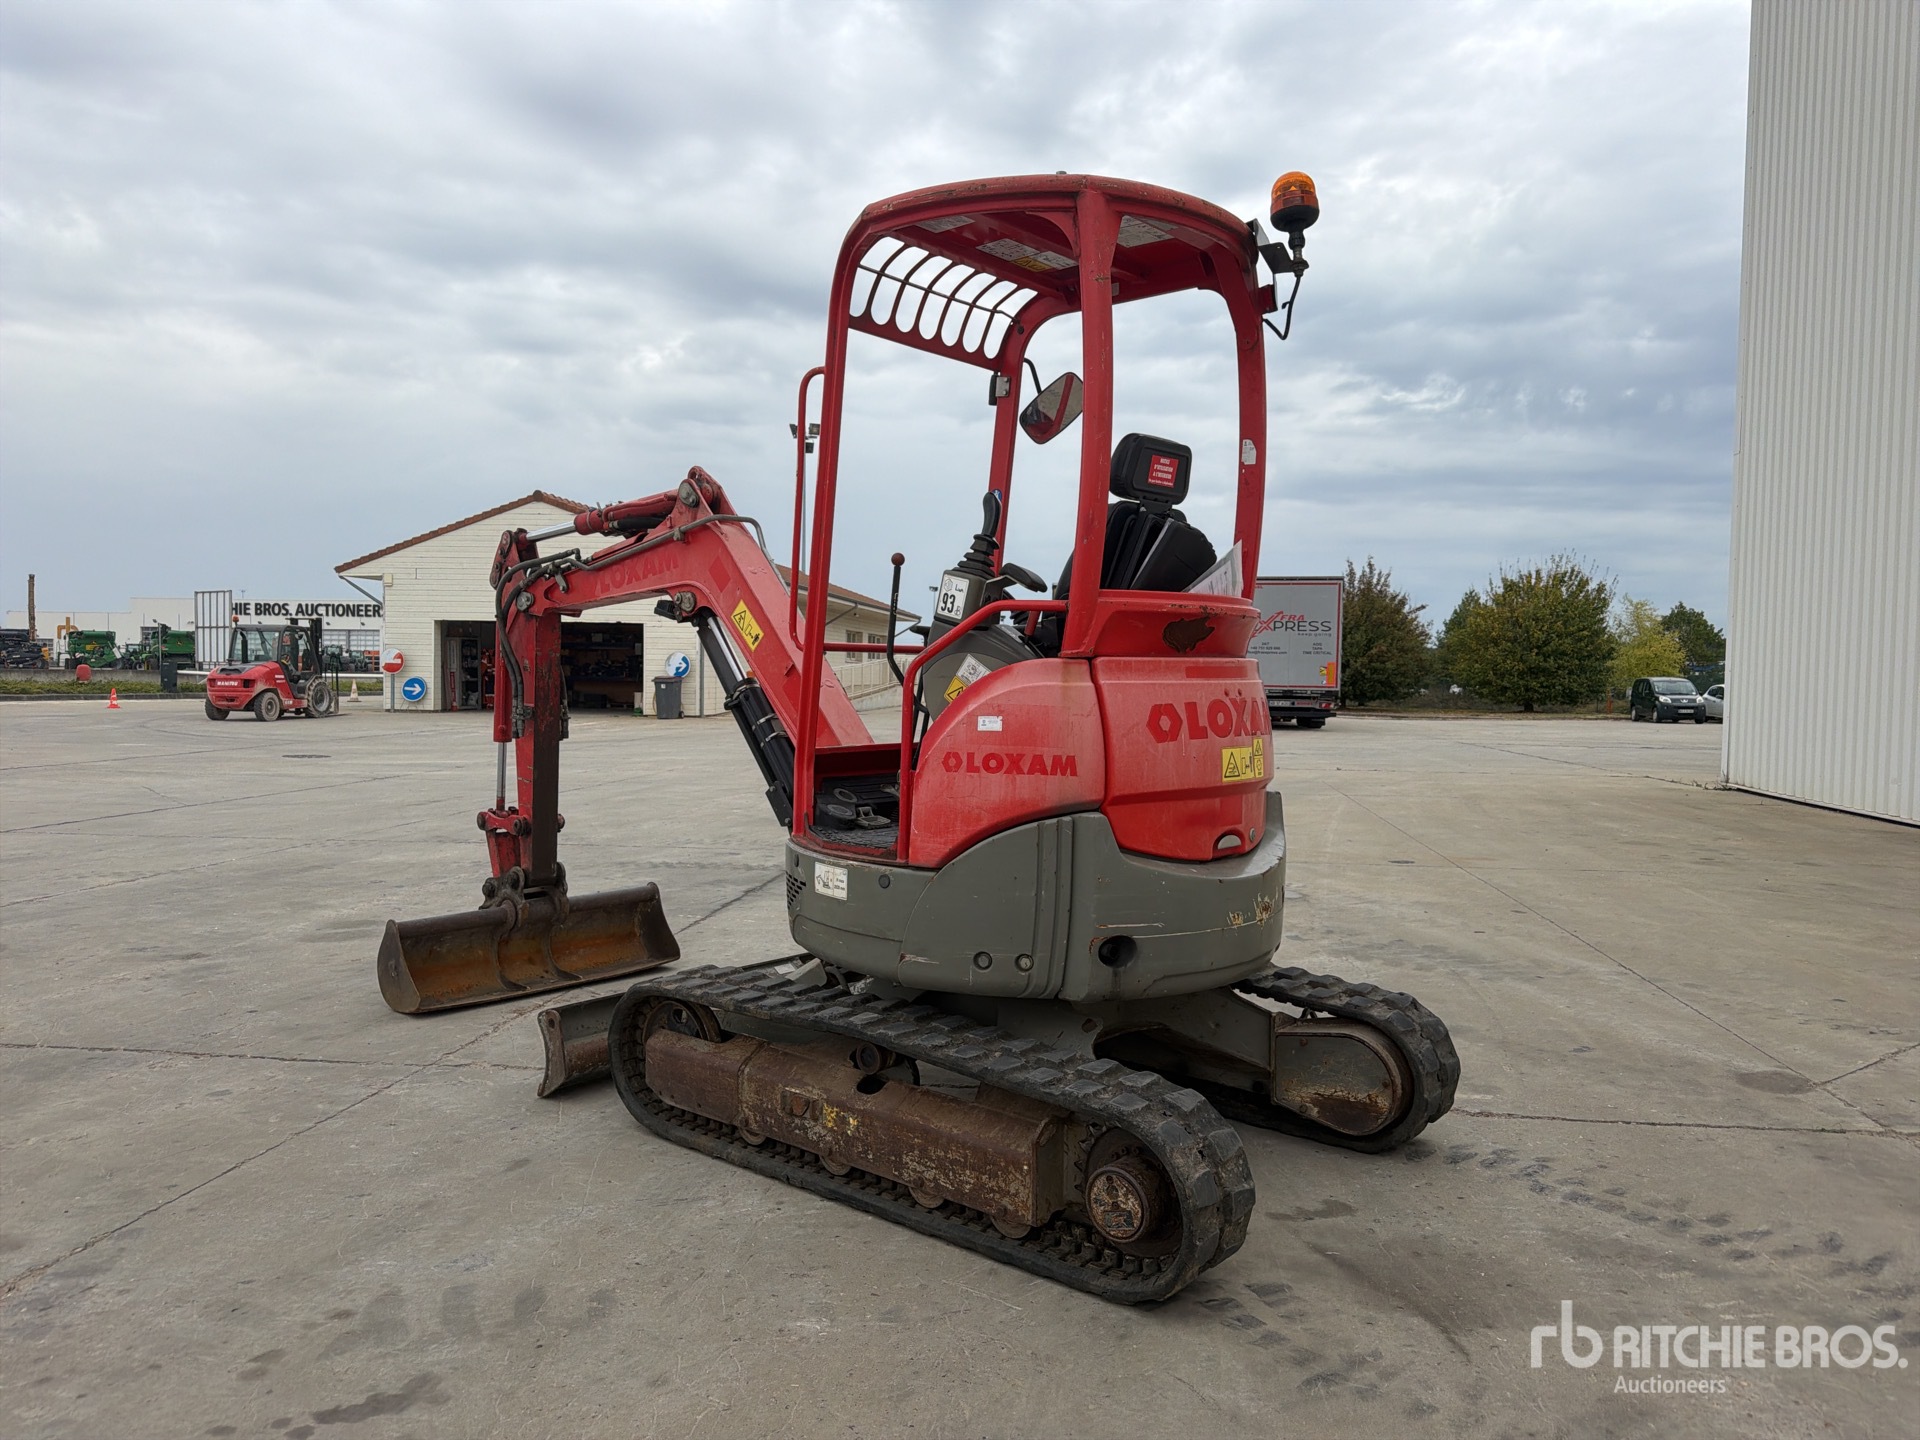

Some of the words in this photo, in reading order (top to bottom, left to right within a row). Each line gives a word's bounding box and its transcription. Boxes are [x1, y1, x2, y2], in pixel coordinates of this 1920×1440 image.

[599, 551, 679, 594] LOXAM
[254, 603, 293, 616] BROS.
[295, 603, 383, 618] AUCTIONEER
[941, 592, 956, 613] 93
[965, 752, 1078, 777] LOXAM
